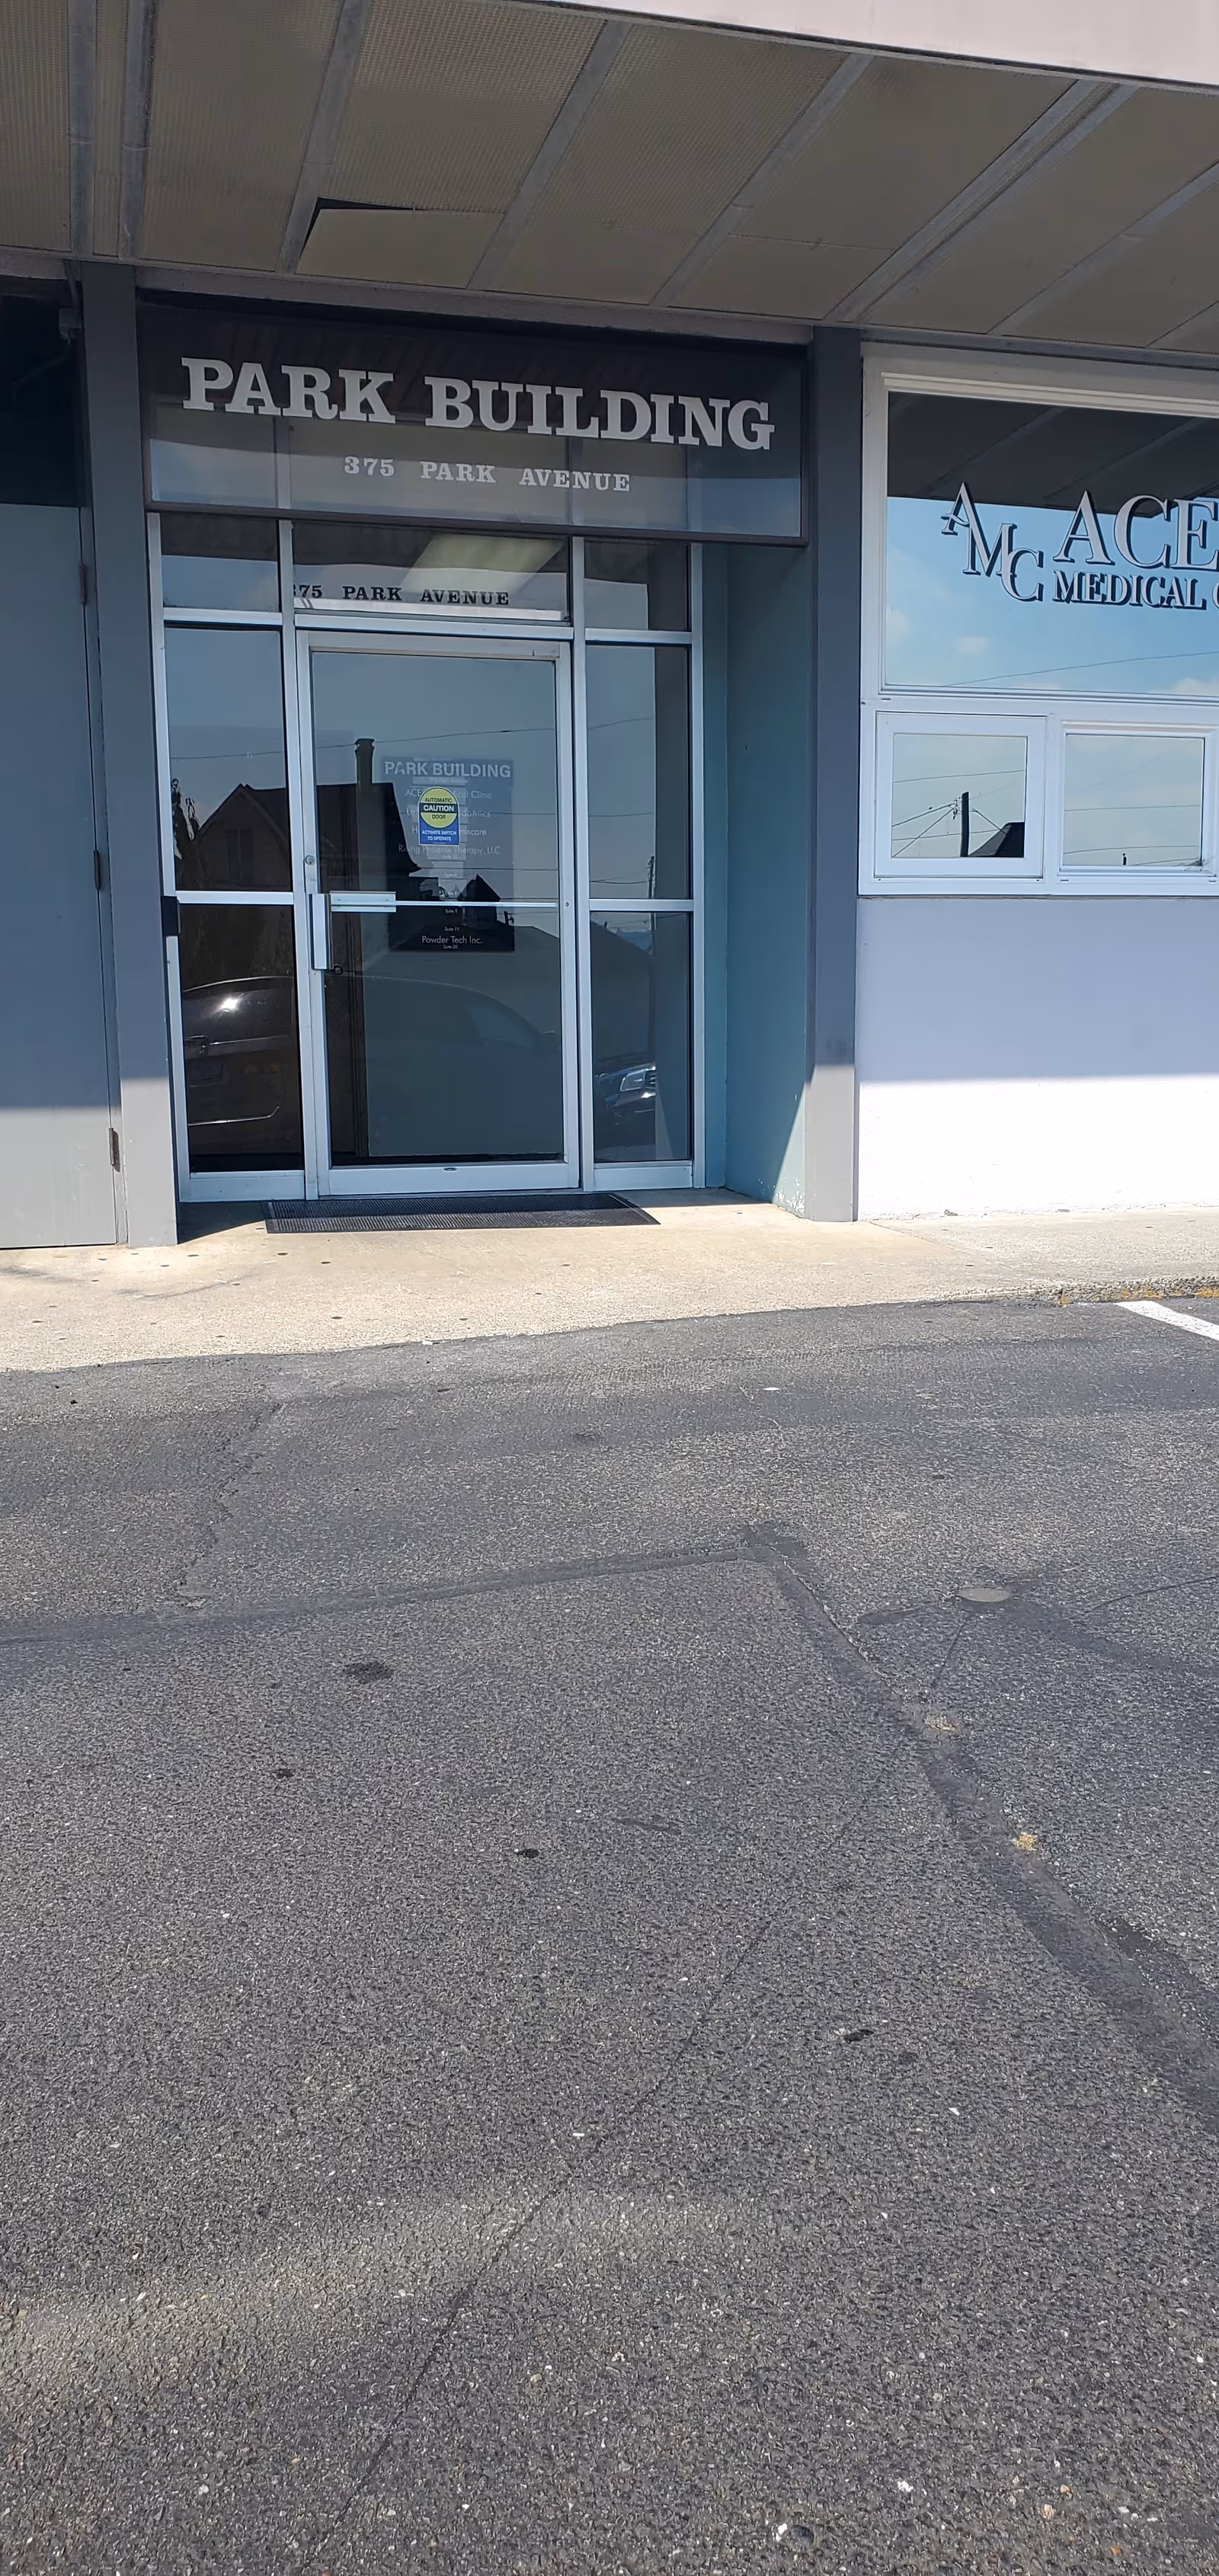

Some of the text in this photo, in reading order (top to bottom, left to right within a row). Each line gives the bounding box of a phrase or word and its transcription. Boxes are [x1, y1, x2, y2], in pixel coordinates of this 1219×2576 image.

[181, 357, 776, 450] PARK BUILDING
[343, 456, 631, 493] 375 PARK AVENUE
[342, 586, 403, 601] PARK
[421, 589, 510, 606] AVENUE
[1053, 570, 1207, 610] MEDICAL
[385, 761, 511, 778] PARK BUILDING
[471, 789, 492, 799] Clinic
[487, 846, 501, 854] LLC
[421, 936, 483, 944] Powder Tech Inc.
